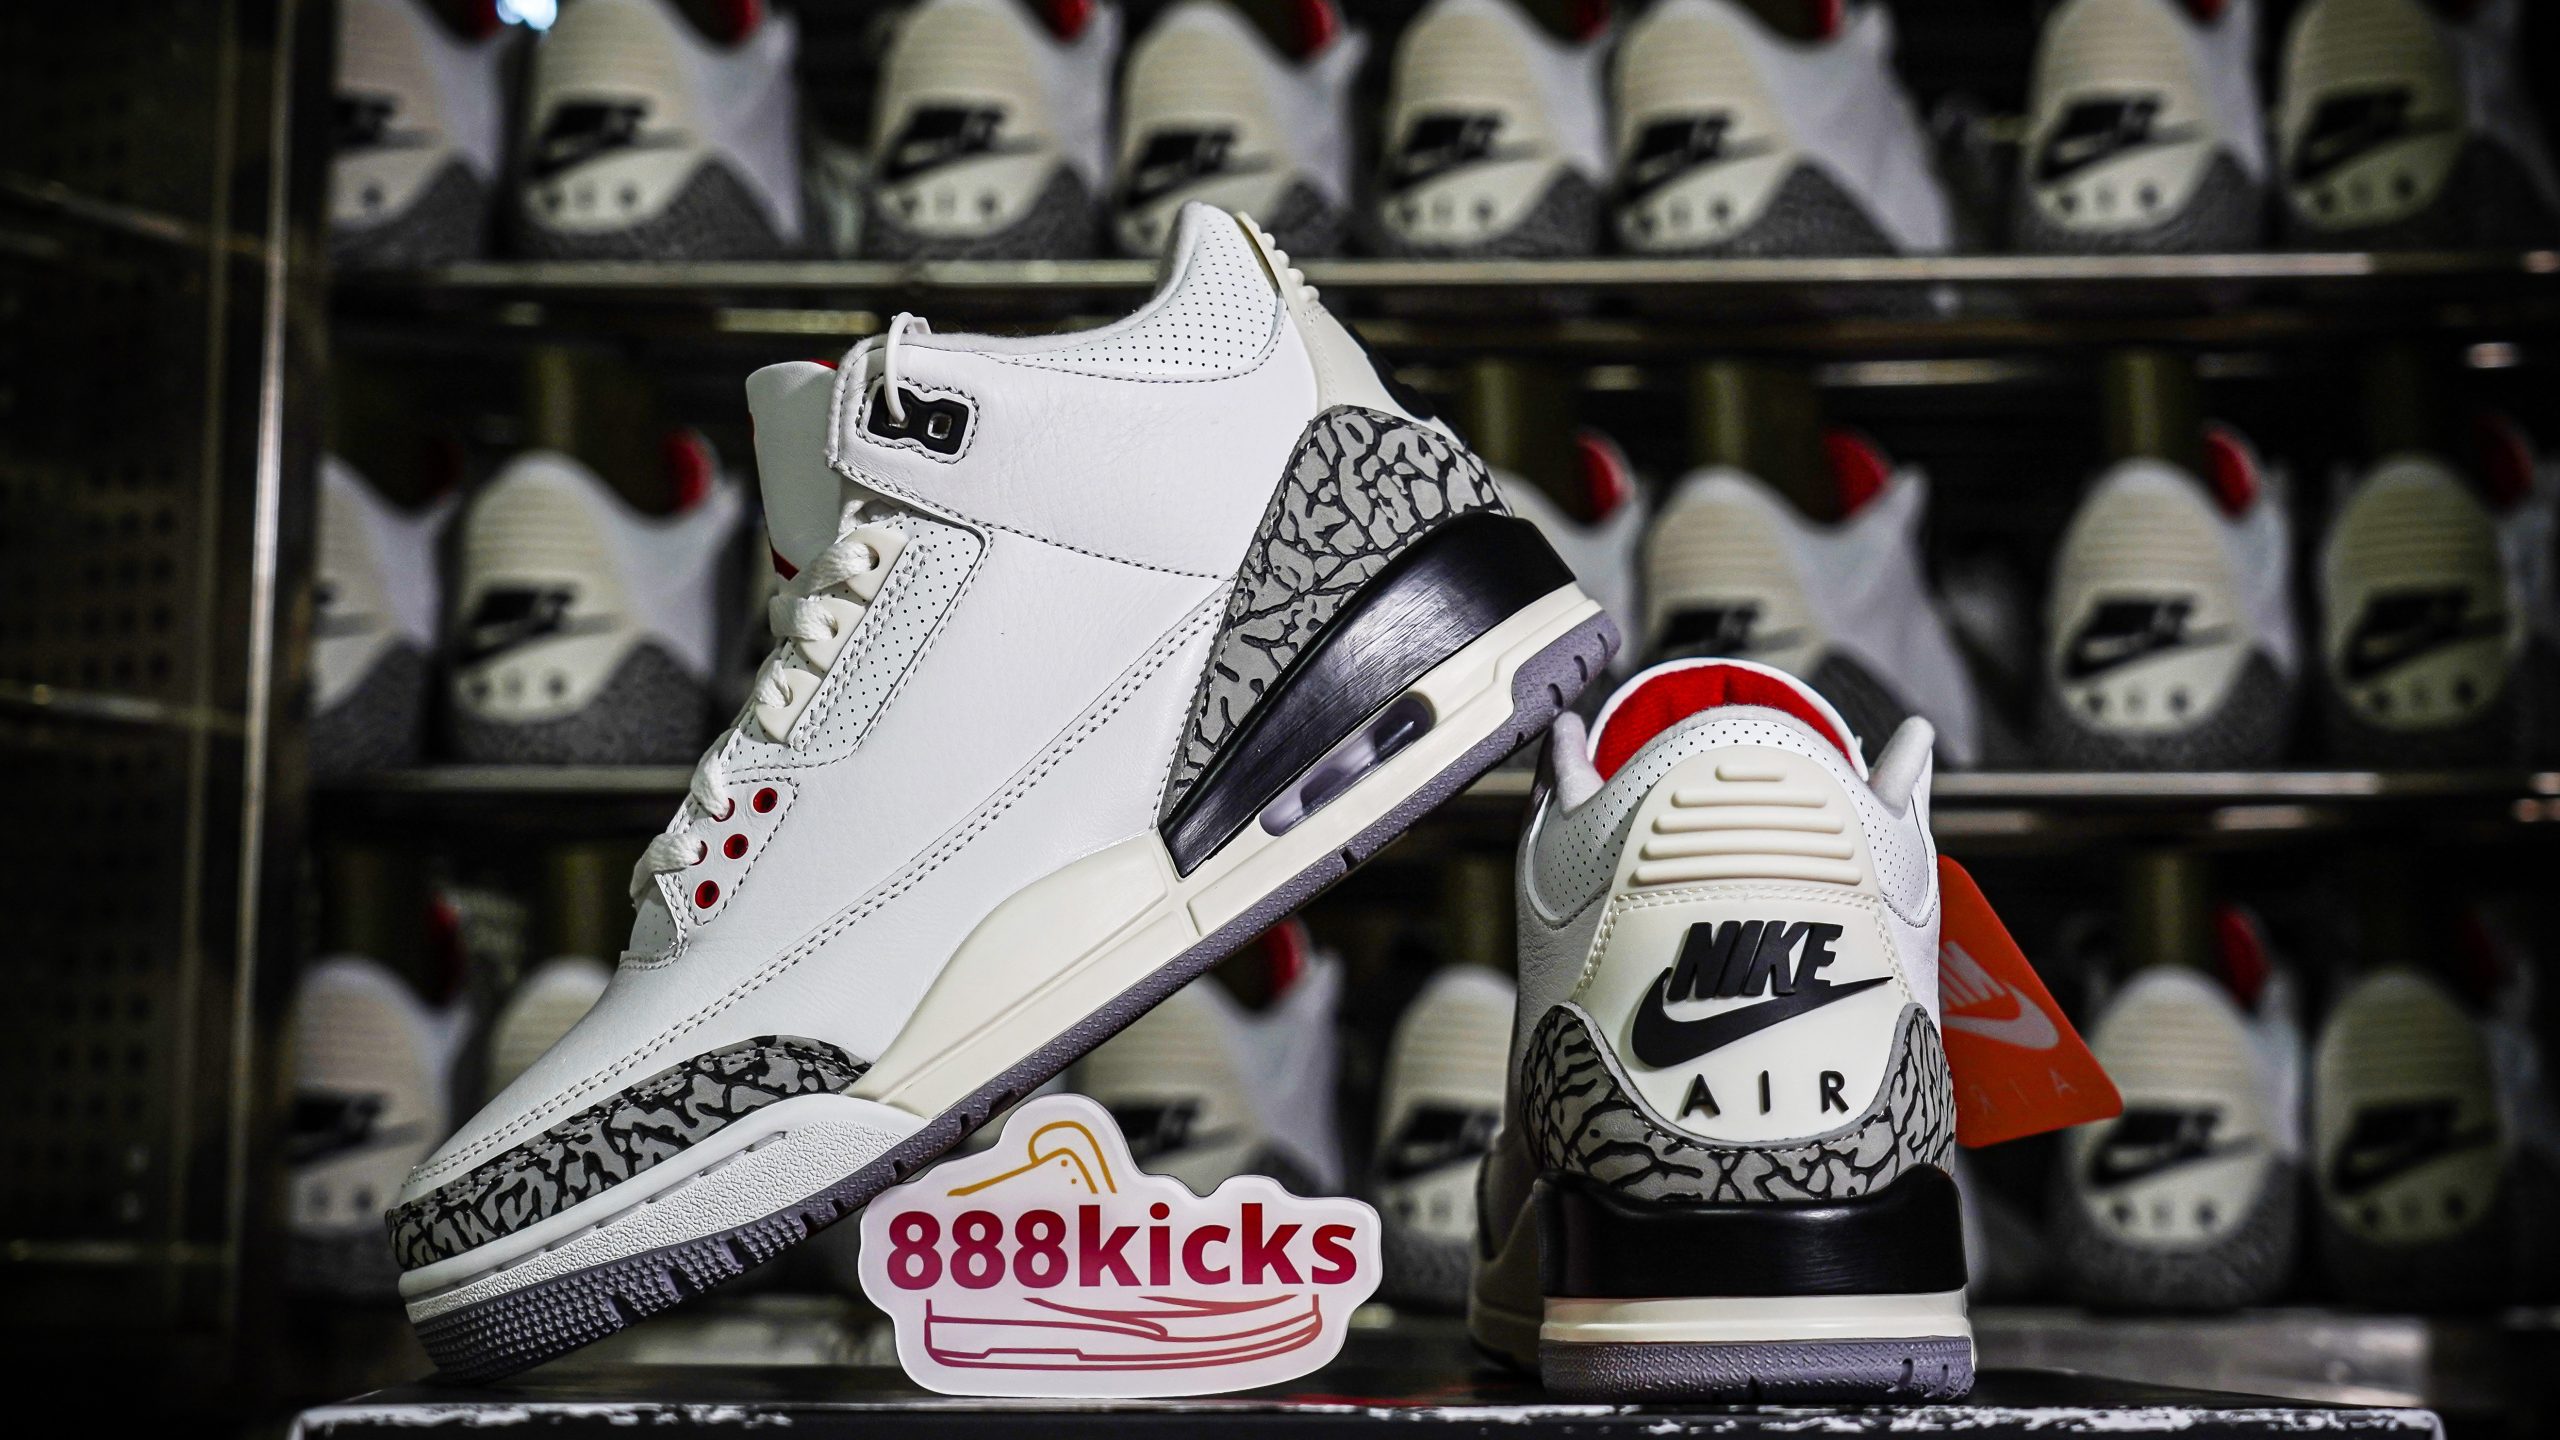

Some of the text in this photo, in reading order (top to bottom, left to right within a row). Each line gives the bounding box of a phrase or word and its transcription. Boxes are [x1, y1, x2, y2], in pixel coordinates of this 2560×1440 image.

[1666, 920, 1843, 1000] NIKE
[1682, 1070, 1849, 1116] AIR
[886, 1201, 1358, 1290] 888kicks
